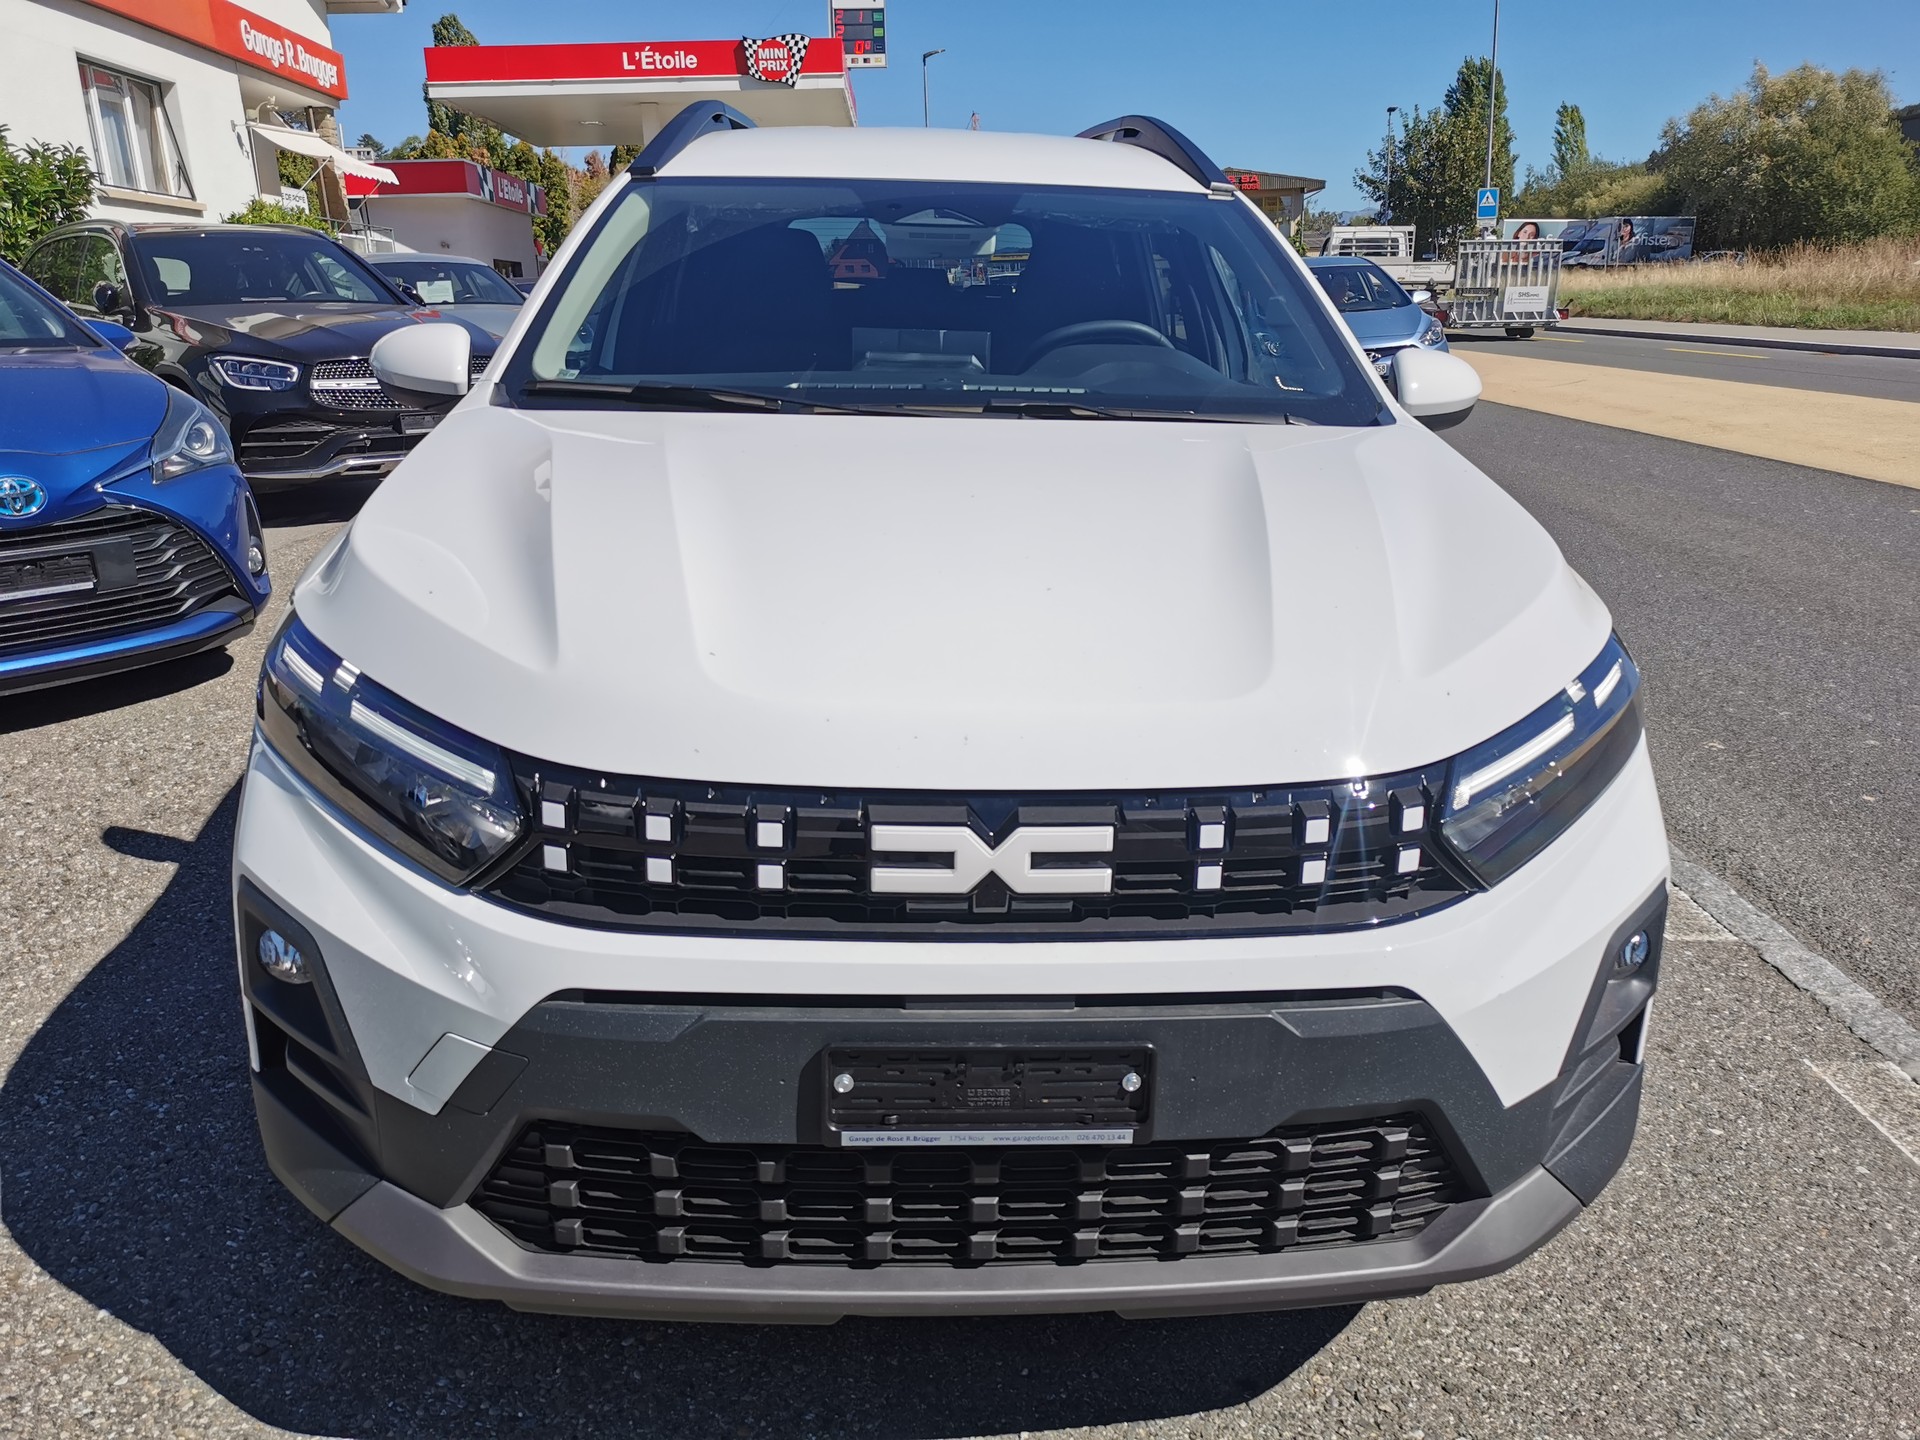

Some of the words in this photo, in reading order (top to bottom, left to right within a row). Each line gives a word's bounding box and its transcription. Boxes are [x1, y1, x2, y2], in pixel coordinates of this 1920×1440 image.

[241, 19, 284, 68] Garage
[622, 46, 698, 70] L'Étoile
[758, 48, 788, 60] MINI
[759, 60, 789, 71] PRIX
